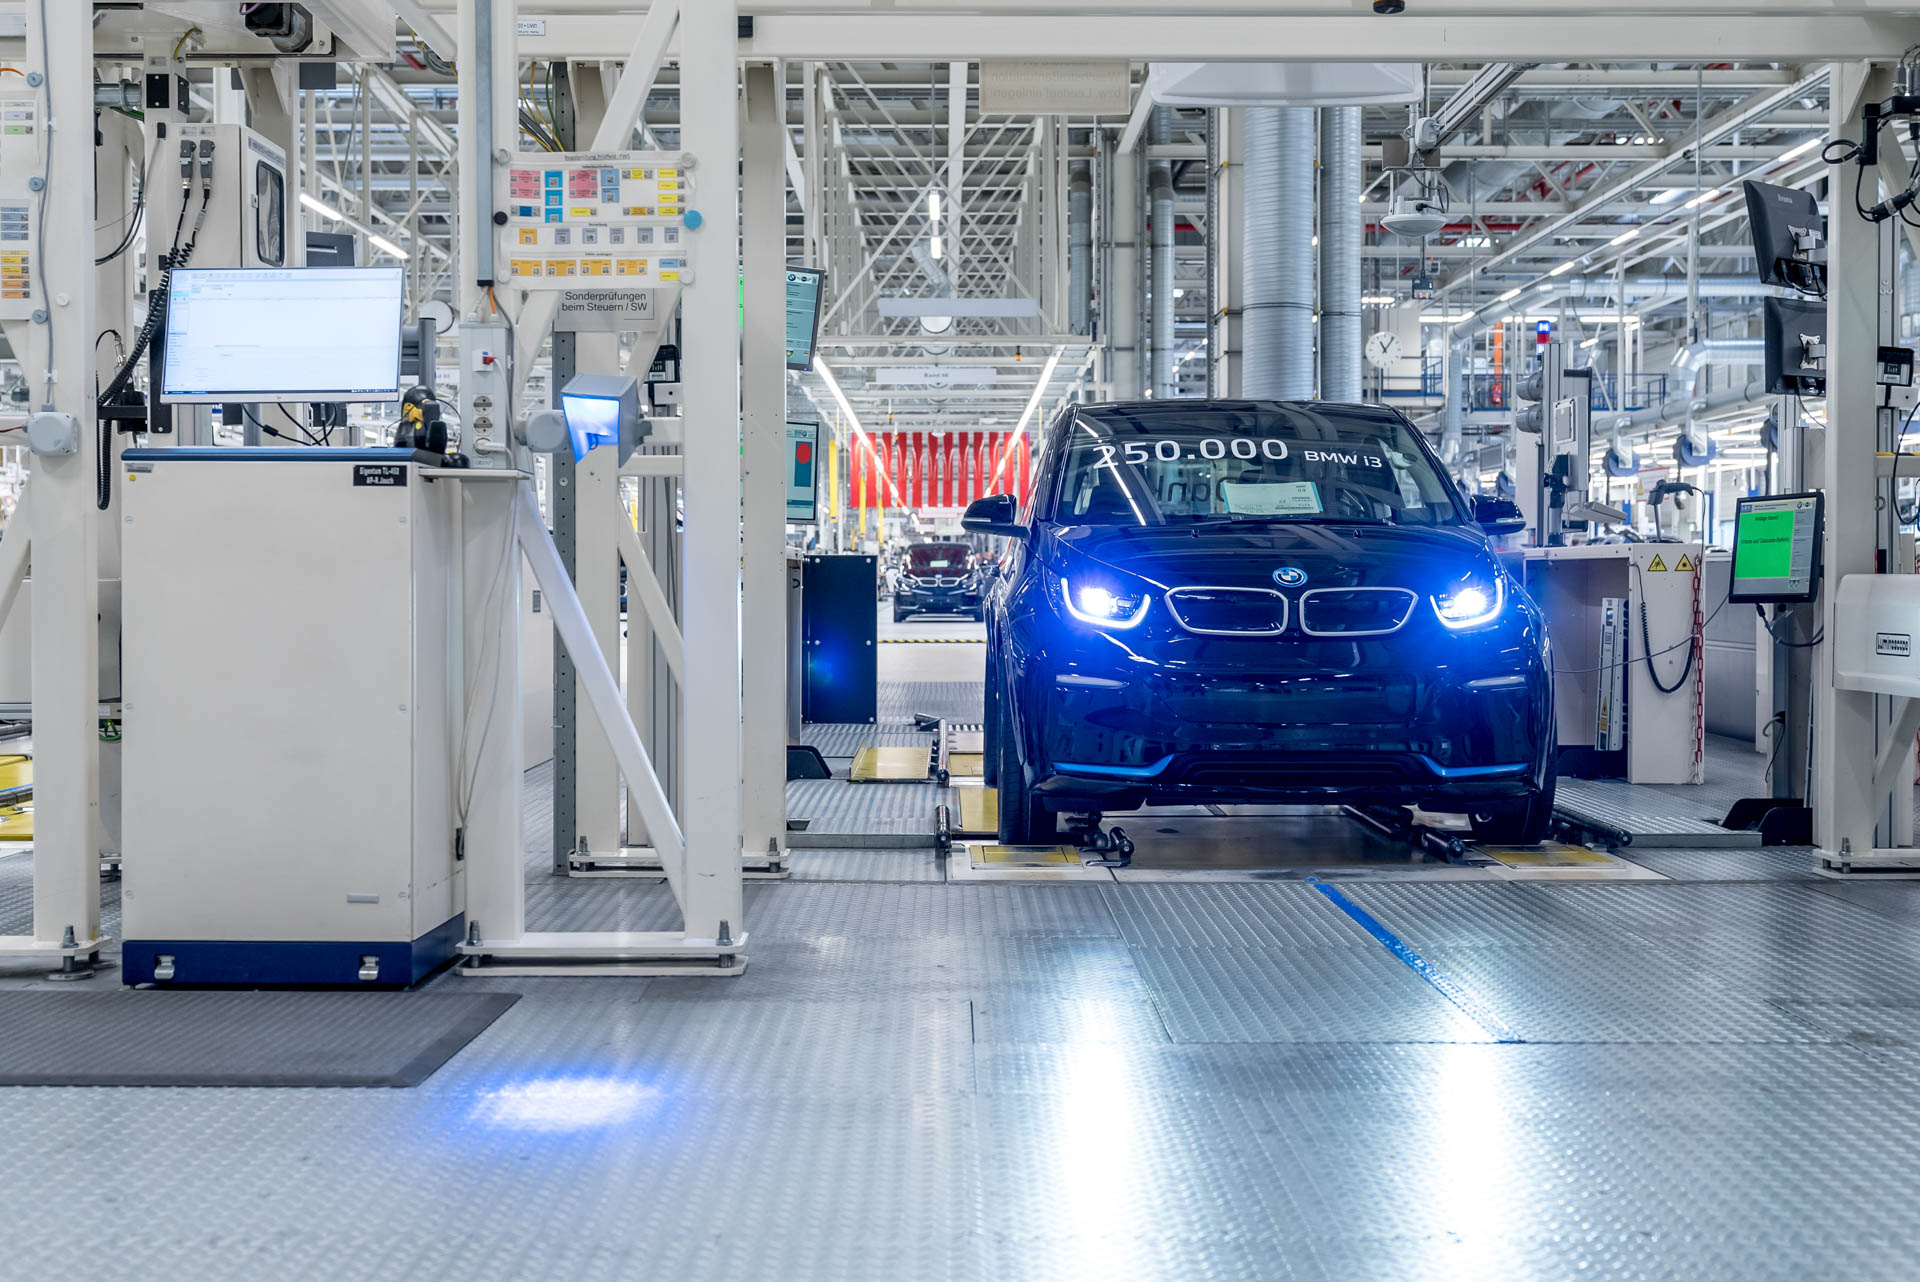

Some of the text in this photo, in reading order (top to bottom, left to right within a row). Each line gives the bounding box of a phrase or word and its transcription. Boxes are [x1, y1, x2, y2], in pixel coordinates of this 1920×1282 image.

[564, 291, 646, 302] Sonderprüfungen
[561, 302, 648, 312] beim Steuern / SW
[1092, 438, 1289, 469] 250.000
[1303, 450, 1383, 468] BMW i3
